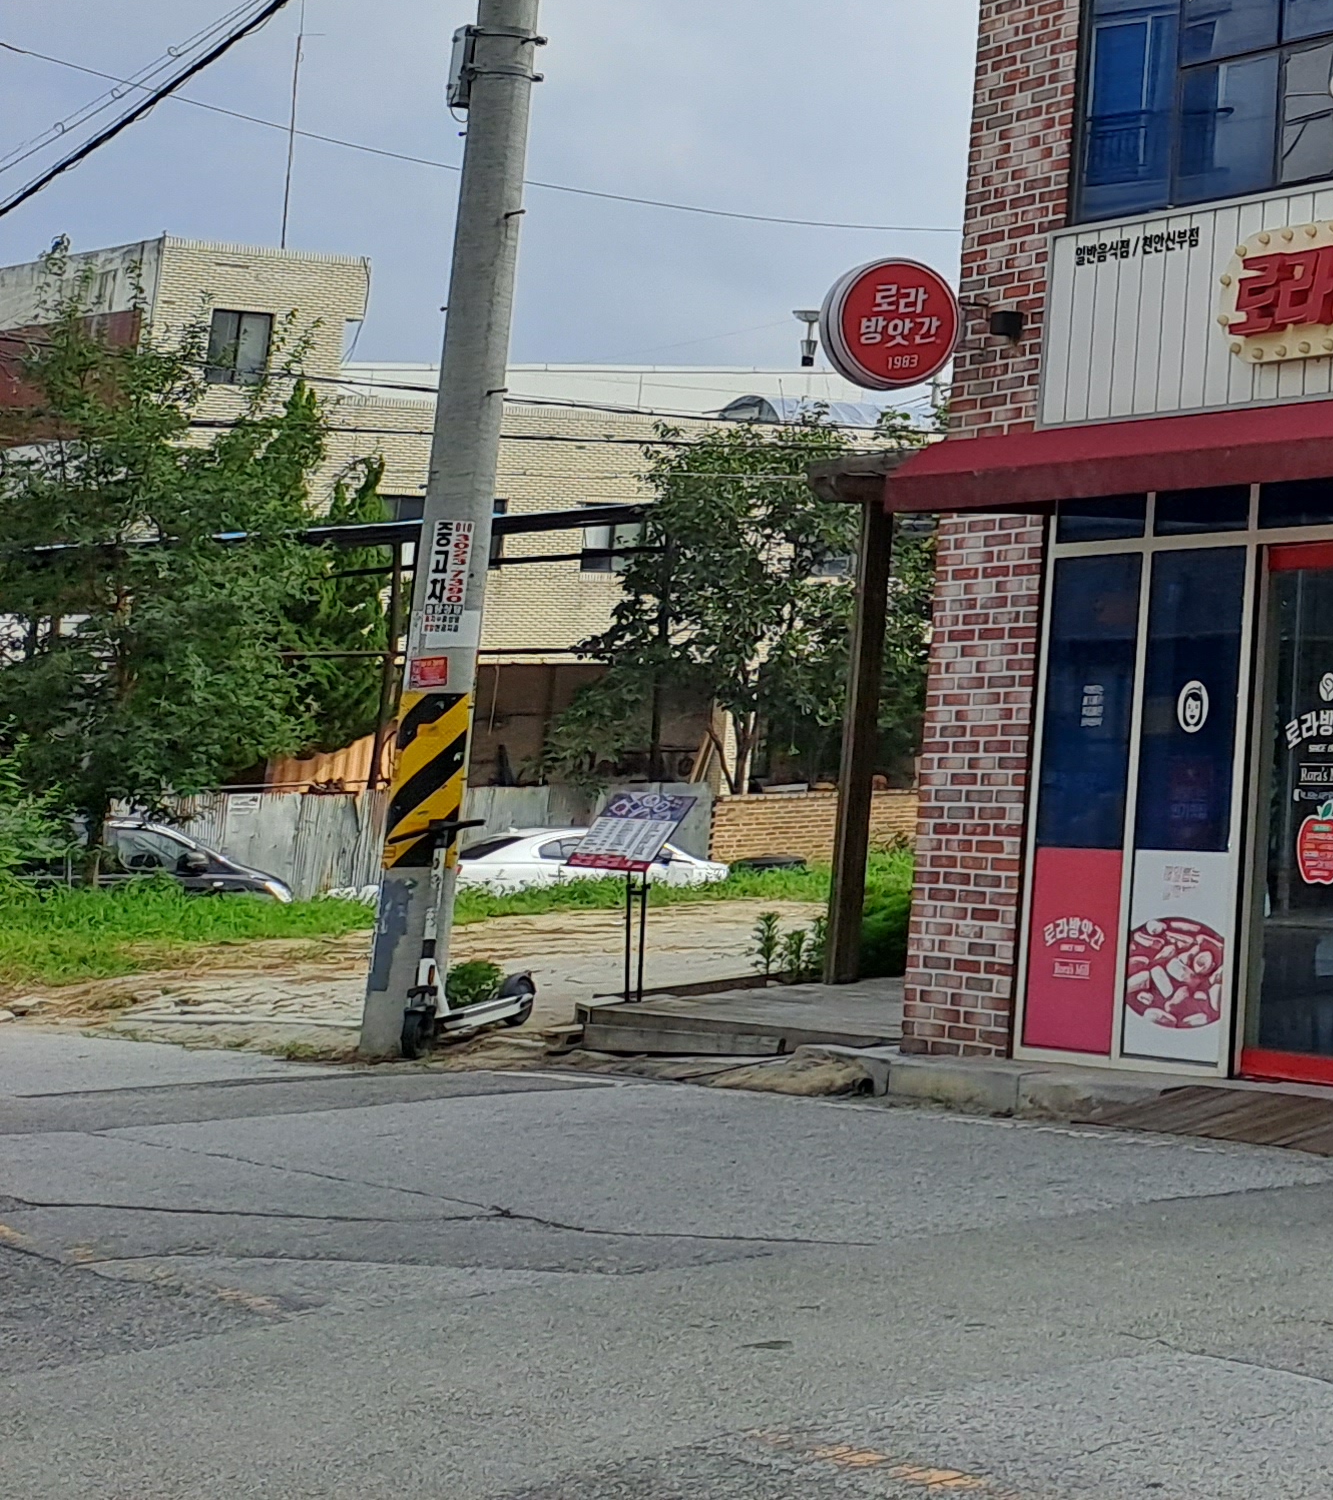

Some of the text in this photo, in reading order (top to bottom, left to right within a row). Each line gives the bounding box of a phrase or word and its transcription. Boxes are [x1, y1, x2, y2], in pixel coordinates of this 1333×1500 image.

[1075, 238, 1131, 266] 일반음식점
[1142, 227, 1200, 256] 천안신부점
[872, 284, 928, 314] 로라
[860, 316, 942, 348] 방앗간
[887, 354, 919, 370] 1983
[455, 522, 472, 533] 010
[427, 522, 454, 603] 중고차
[1300, 766, 1328, 782] Rora's
[1043, 917, 1105, 950] 로라방앗간
